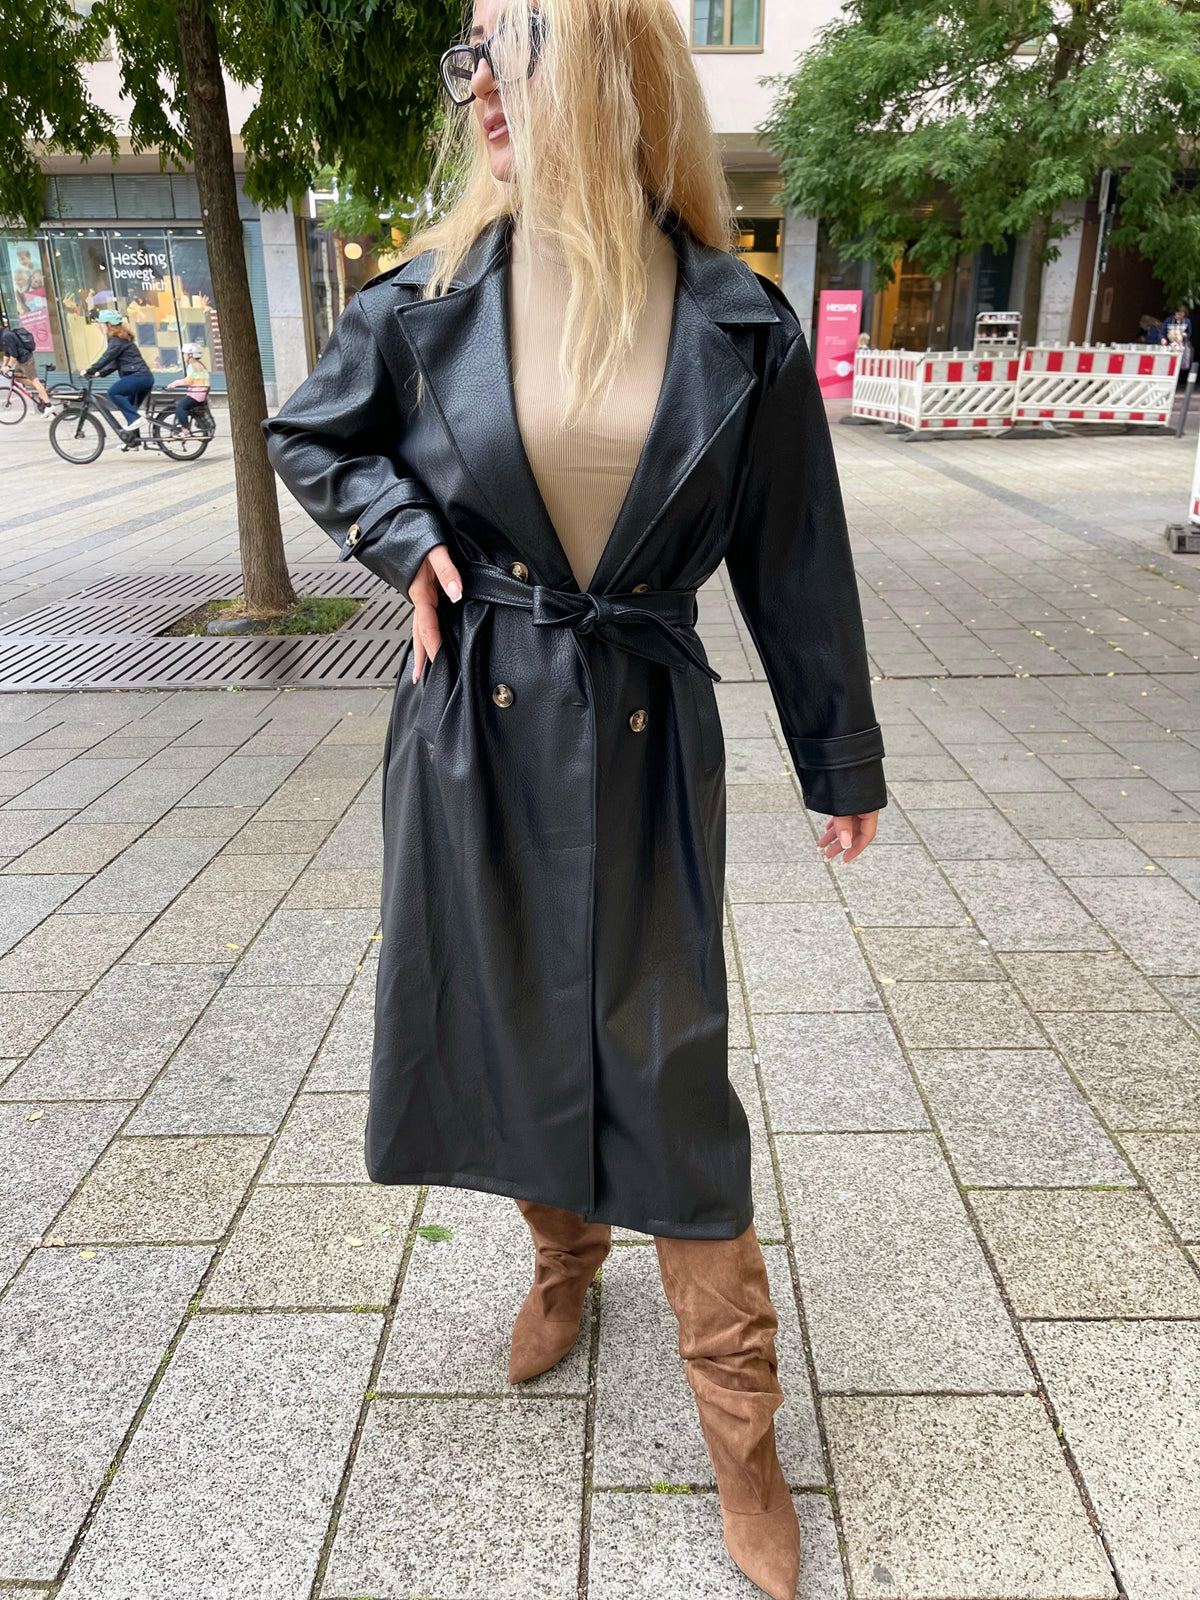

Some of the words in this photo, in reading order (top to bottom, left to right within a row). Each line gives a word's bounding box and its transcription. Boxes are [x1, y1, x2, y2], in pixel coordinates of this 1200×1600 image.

[110, 251, 167, 269] Hessing
[113, 267, 155, 281] bewegt
[141, 280, 168, 291] mich
